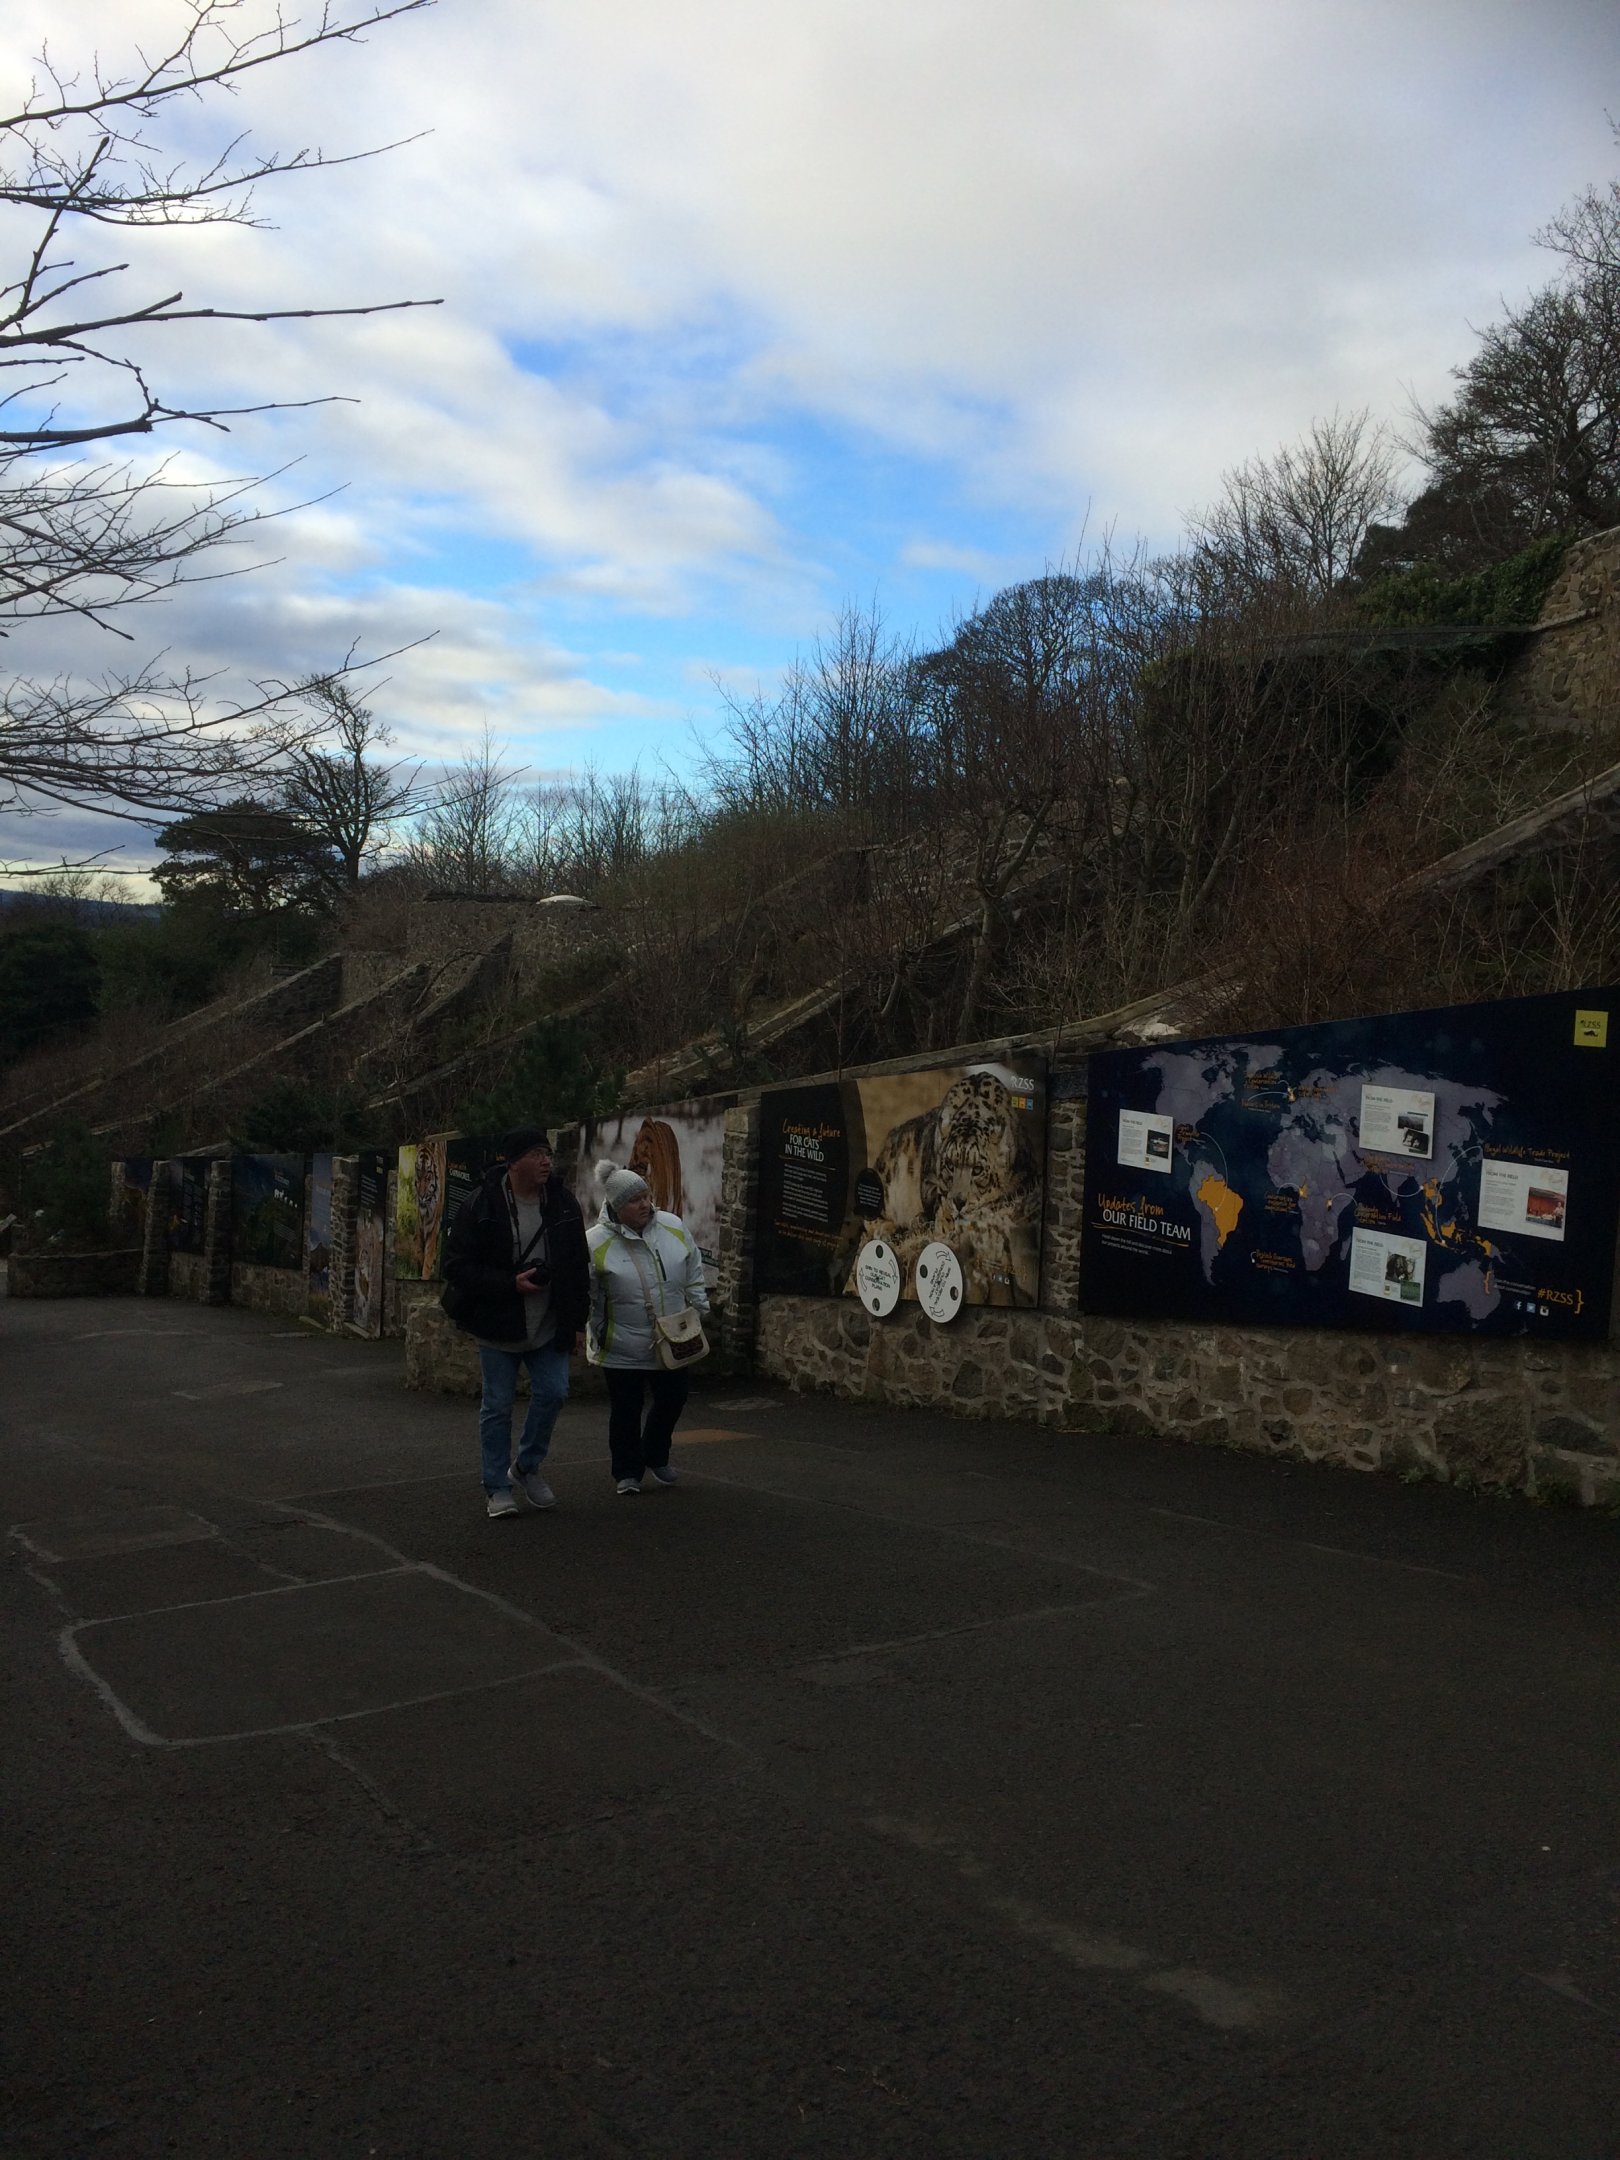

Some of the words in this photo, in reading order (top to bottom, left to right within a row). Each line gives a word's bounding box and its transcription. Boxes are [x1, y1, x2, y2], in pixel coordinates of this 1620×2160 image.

[1009, 1076, 1034, 1090] RZSS
[789, 1133, 803, 1146] FOR
[803, 1136, 820, 1150] CATS
[784, 1143, 793, 1155] IN
[793, 1145, 806, 1158] THE
[806, 1149, 824, 1162] WILD
[1097, 1192, 1136, 1211] Updates
[1138, 1195, 1165, 1217] from
[1102, 1208, 1127, 1226] OUR
[1128, 1214, 1157, 1233] FIELD
[1159, 1221, 1192, 1241] TEAM
[1537, 1288, 1574, 1305] #RZSS
